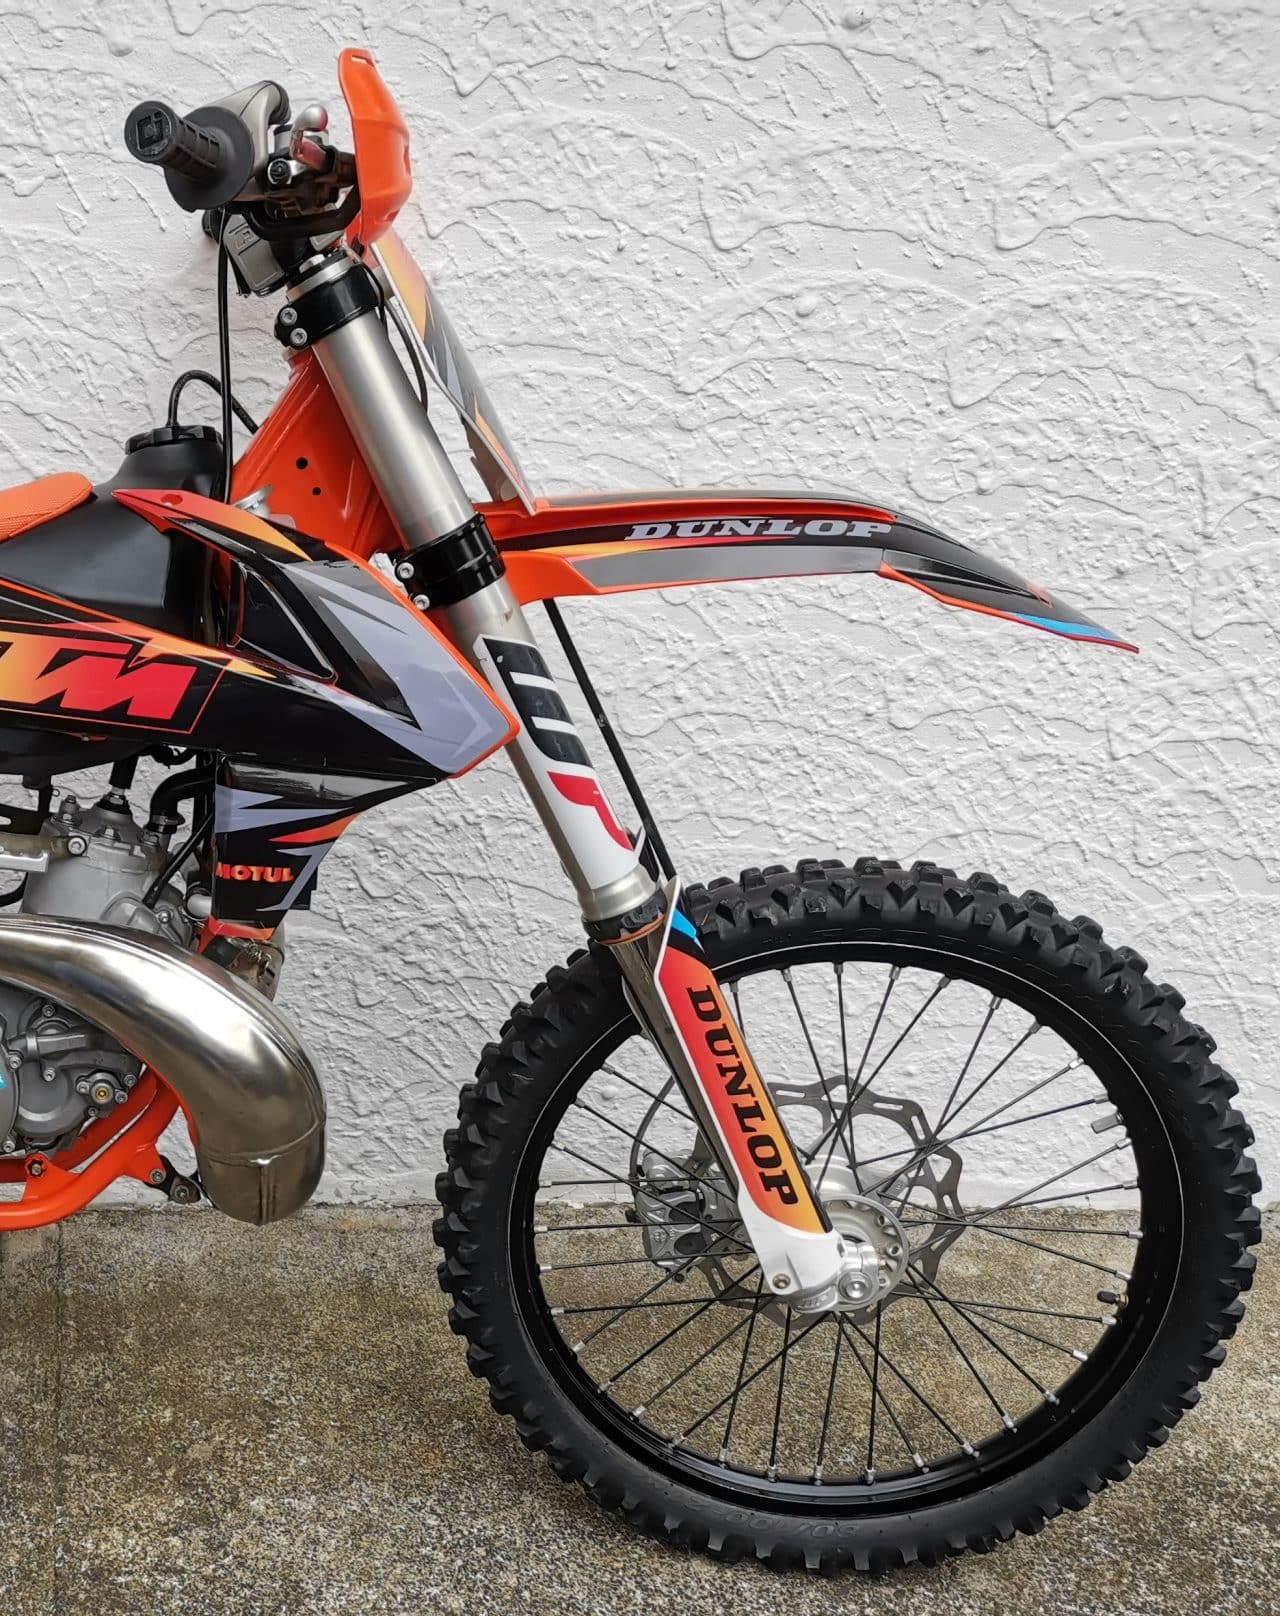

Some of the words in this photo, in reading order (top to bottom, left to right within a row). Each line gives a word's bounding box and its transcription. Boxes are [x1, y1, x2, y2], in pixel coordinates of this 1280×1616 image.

[624, 518, 892, 541] DUNLOP
[216, 862, 294, 883] MOTUL
[687, 985, 798, 1206] DUNLOP
